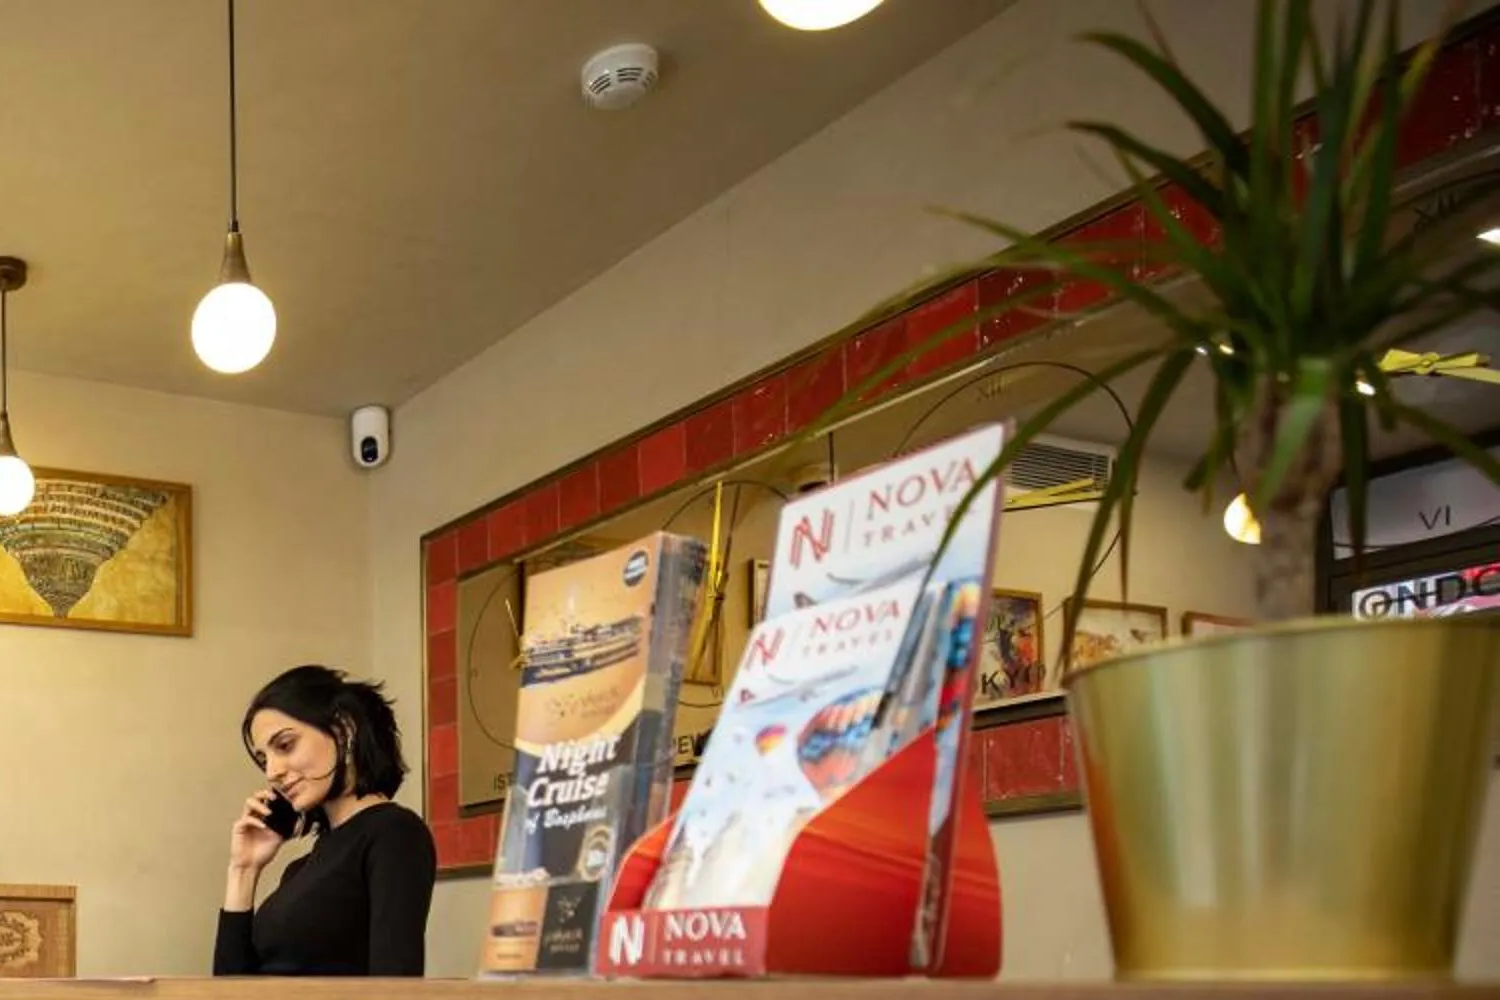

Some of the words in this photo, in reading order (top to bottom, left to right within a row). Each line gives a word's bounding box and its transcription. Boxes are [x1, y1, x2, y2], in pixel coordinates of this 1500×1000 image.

[866, 457, 976, 521] NOVA
[1418, 504, 1450, 530] VI
[809, 599, 900, 640] NOVA
[536, 732, 621, 775] Night
[527, 771, 610, 807] Cruise
[663, 912, 747, 941] NOVA
[662, 949, 745, 966] TRAVEL
